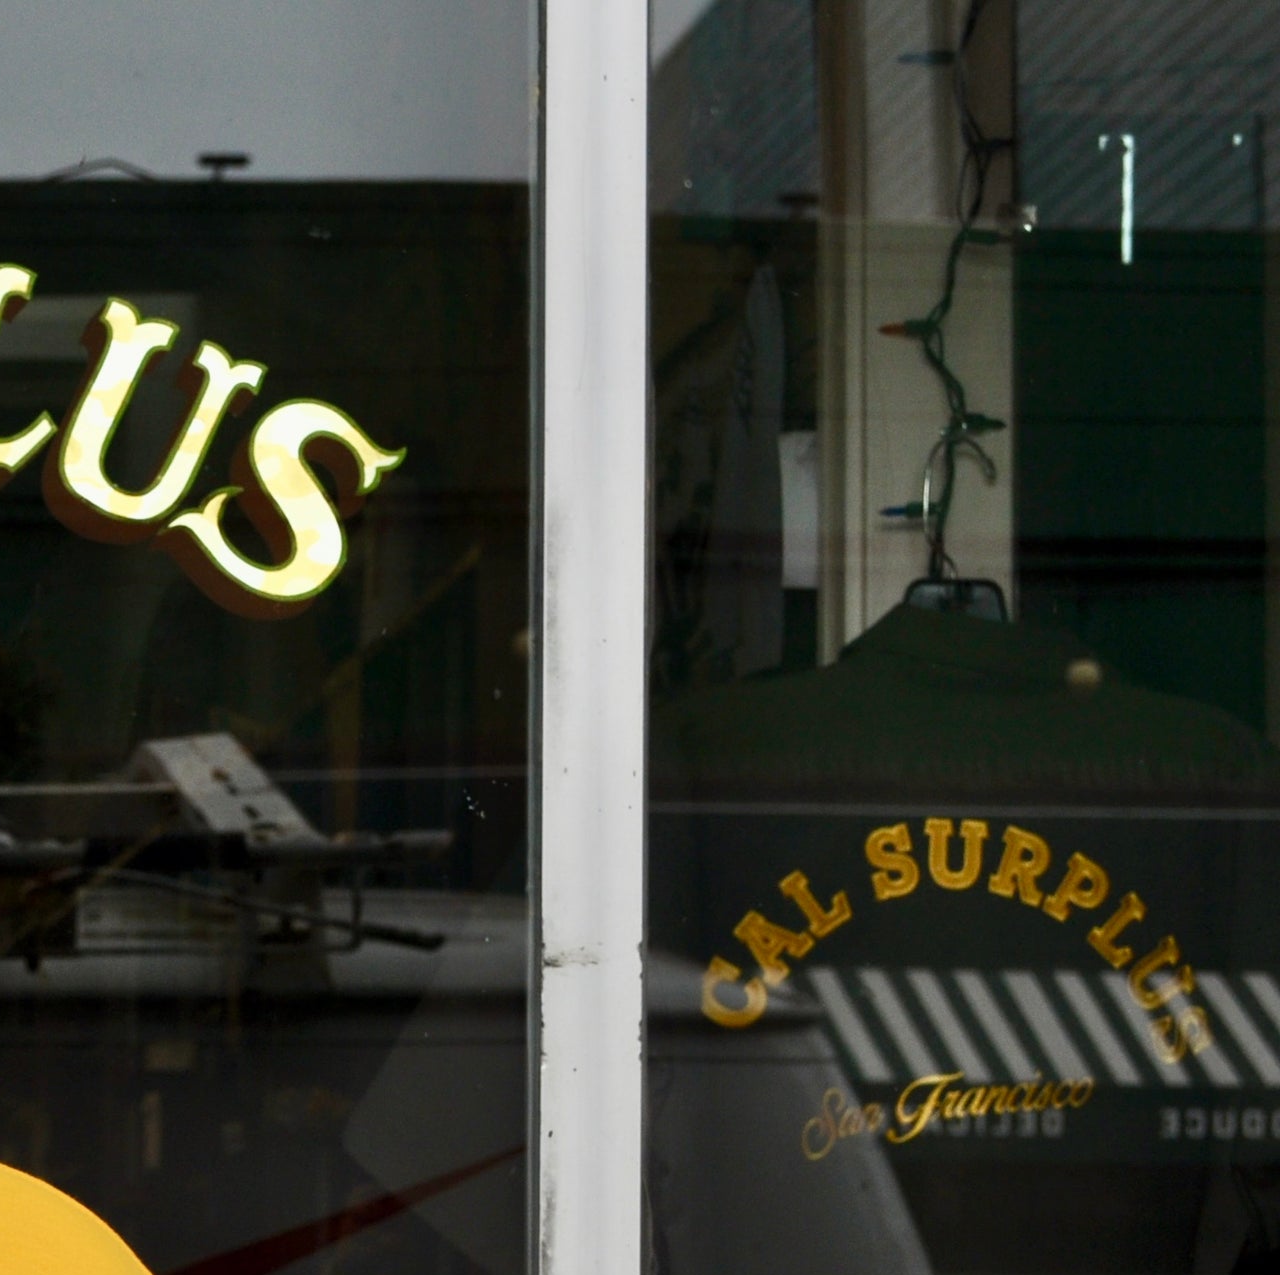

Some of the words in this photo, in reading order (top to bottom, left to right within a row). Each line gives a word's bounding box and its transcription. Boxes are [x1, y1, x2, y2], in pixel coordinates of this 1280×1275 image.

[701, 869, 853, 1029] CAL
[864, 817, 1213, 1065] SURPLUS
[800, 1087, 886, 1161] San
[886, 1070, 1096, 1143] Francisco
